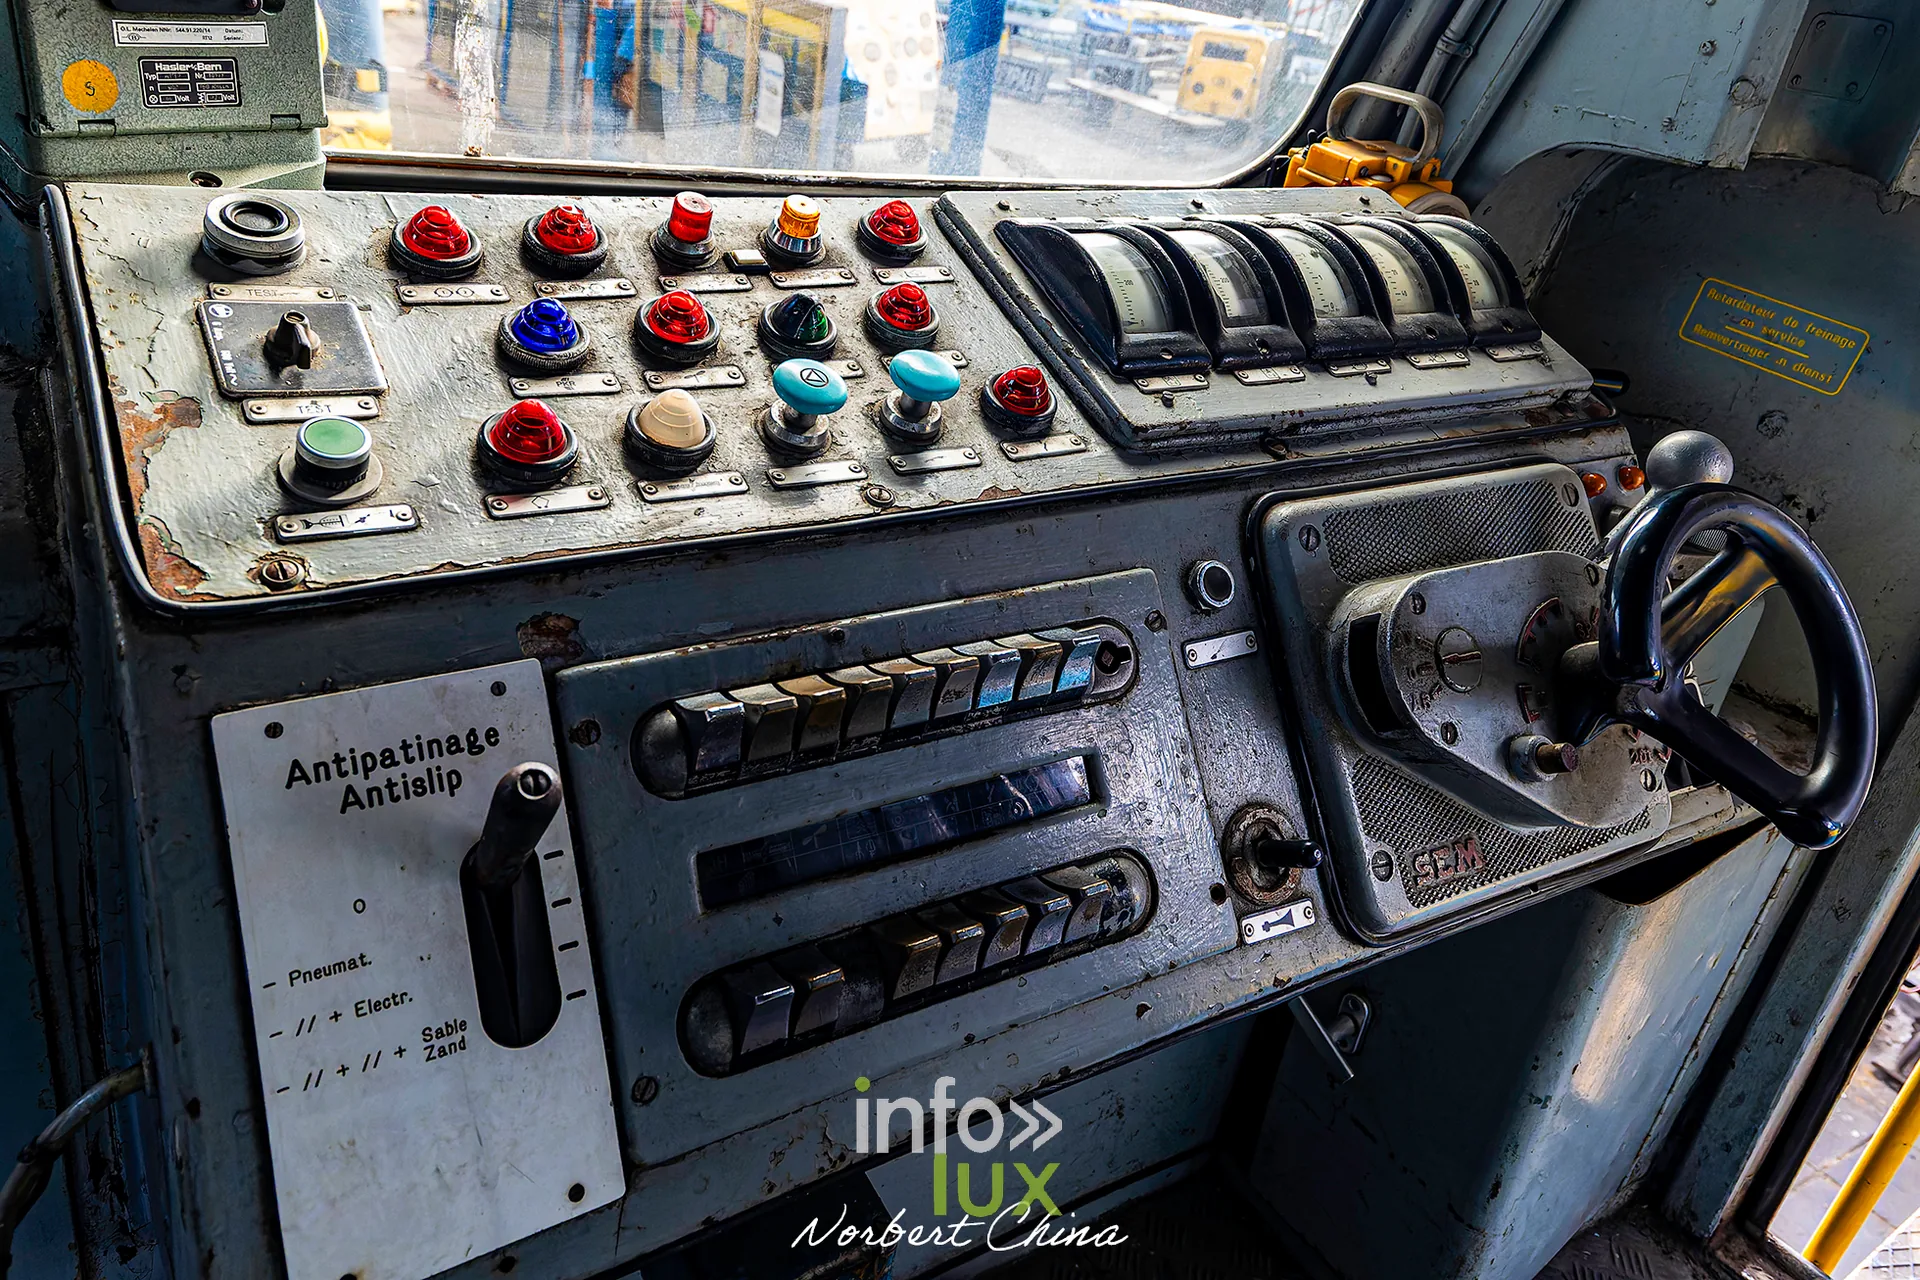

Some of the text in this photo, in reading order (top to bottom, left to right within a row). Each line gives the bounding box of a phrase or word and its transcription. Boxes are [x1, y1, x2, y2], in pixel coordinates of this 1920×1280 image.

[144, 72, 157, 81] Typ
[154, 62, 222, 71] Hasler Bern
[176, 94, 191, 102] Volt
[221, 93, 236, 101] Volt
[1739, 317, 1806, 349] en service
[1782, 314, 1800, 329] de
[1804, 321, 1857, 350] freinage
[1792, 361, 1834, 385] dienst
[285, 726, 500, 790] Antipatinage
[339, 764, 464, 815] Antislip
[288, 952, 373, 988] Pneumat.
[354, 991, 414, 1019] Electr.
[421, 1018, 469, 1044] Sable
[423, 1035, 468, 1063] Zand
